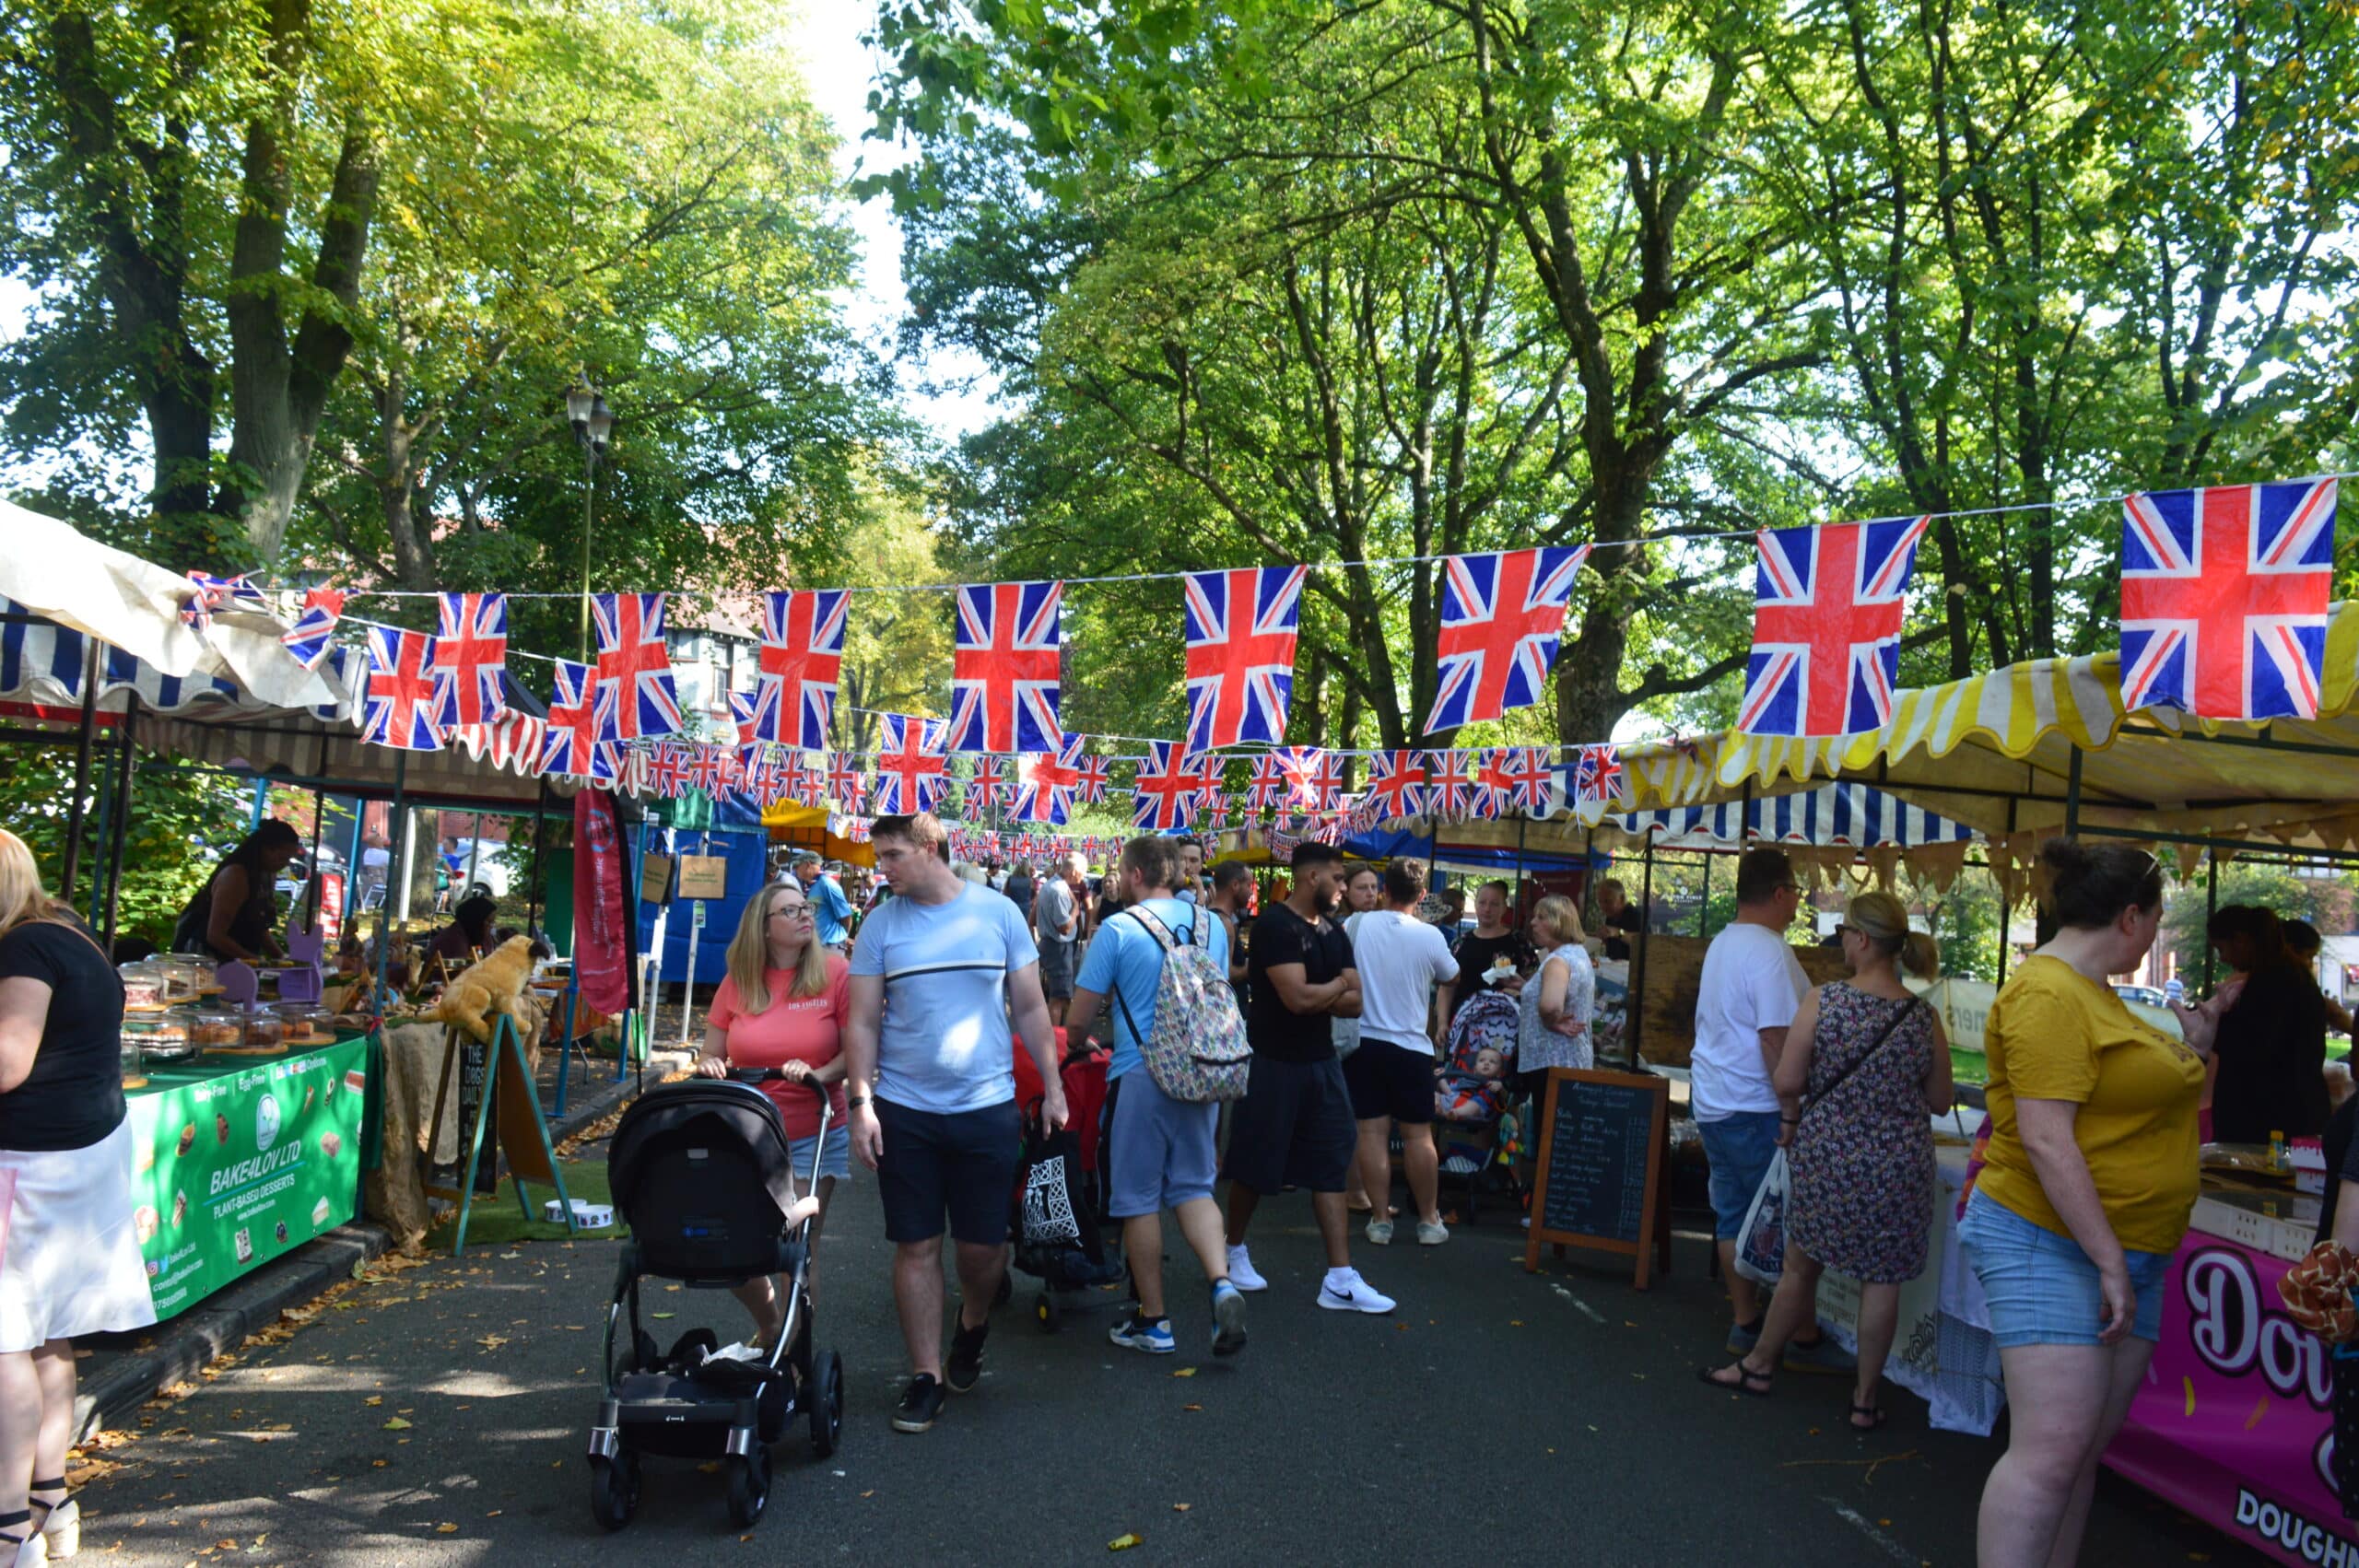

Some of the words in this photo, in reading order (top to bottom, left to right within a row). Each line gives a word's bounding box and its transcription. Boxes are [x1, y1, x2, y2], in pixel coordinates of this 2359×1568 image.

[788, 1002, 801, 1011] LOS
[802, 998, 827, 1010] ANGELES
[467, 1045, 483, 1064] THE
[238, 1073, 266, 1092] Egg-Free
[306, 1057, 327, 1071] Options
[462, 1085, 482, 1105] DAIL
[209, 1147, 281, 1195] BAKE4LOV
[279, 1140, 301, 1167] LTD
[213, 1188, 260, 1220] PLANT-BASED
[259, 1172, 295, 1199] DESSERTS
